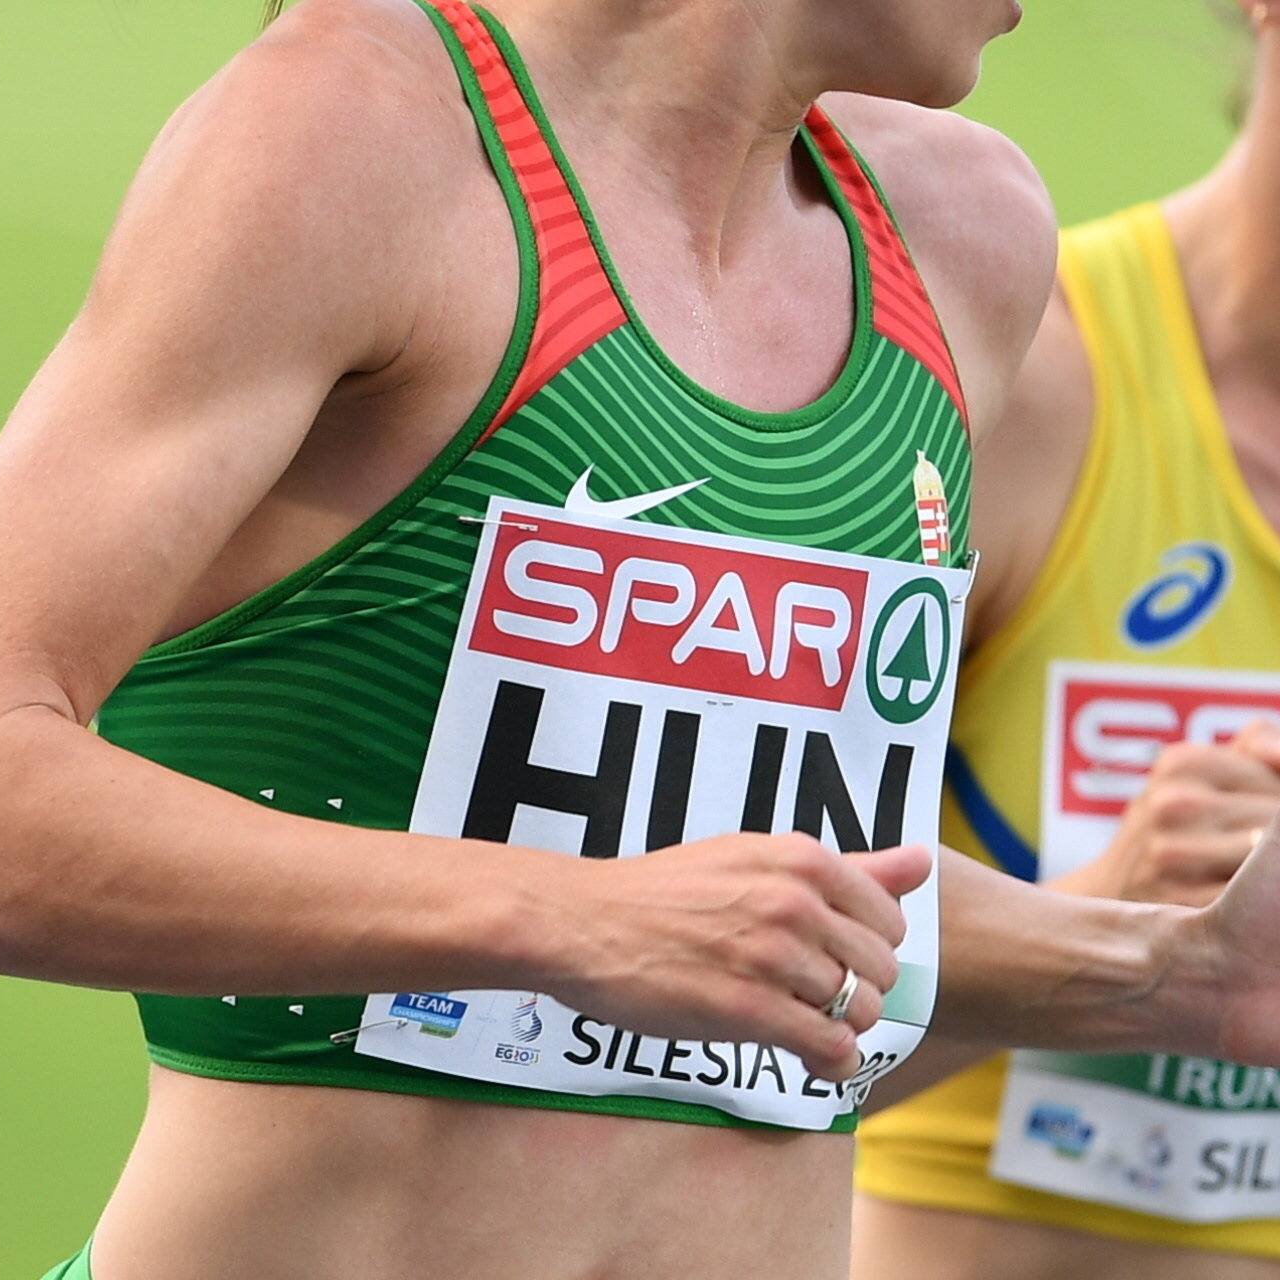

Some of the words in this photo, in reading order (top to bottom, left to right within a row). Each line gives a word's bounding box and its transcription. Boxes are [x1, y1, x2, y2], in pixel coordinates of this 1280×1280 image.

[493, 539, 853, 688] SPAR
[460, 679, 916, 865] HUN
[408, 993, 454, 1016] TEAM
[563, 1014, 787, 1094] SILESIA
